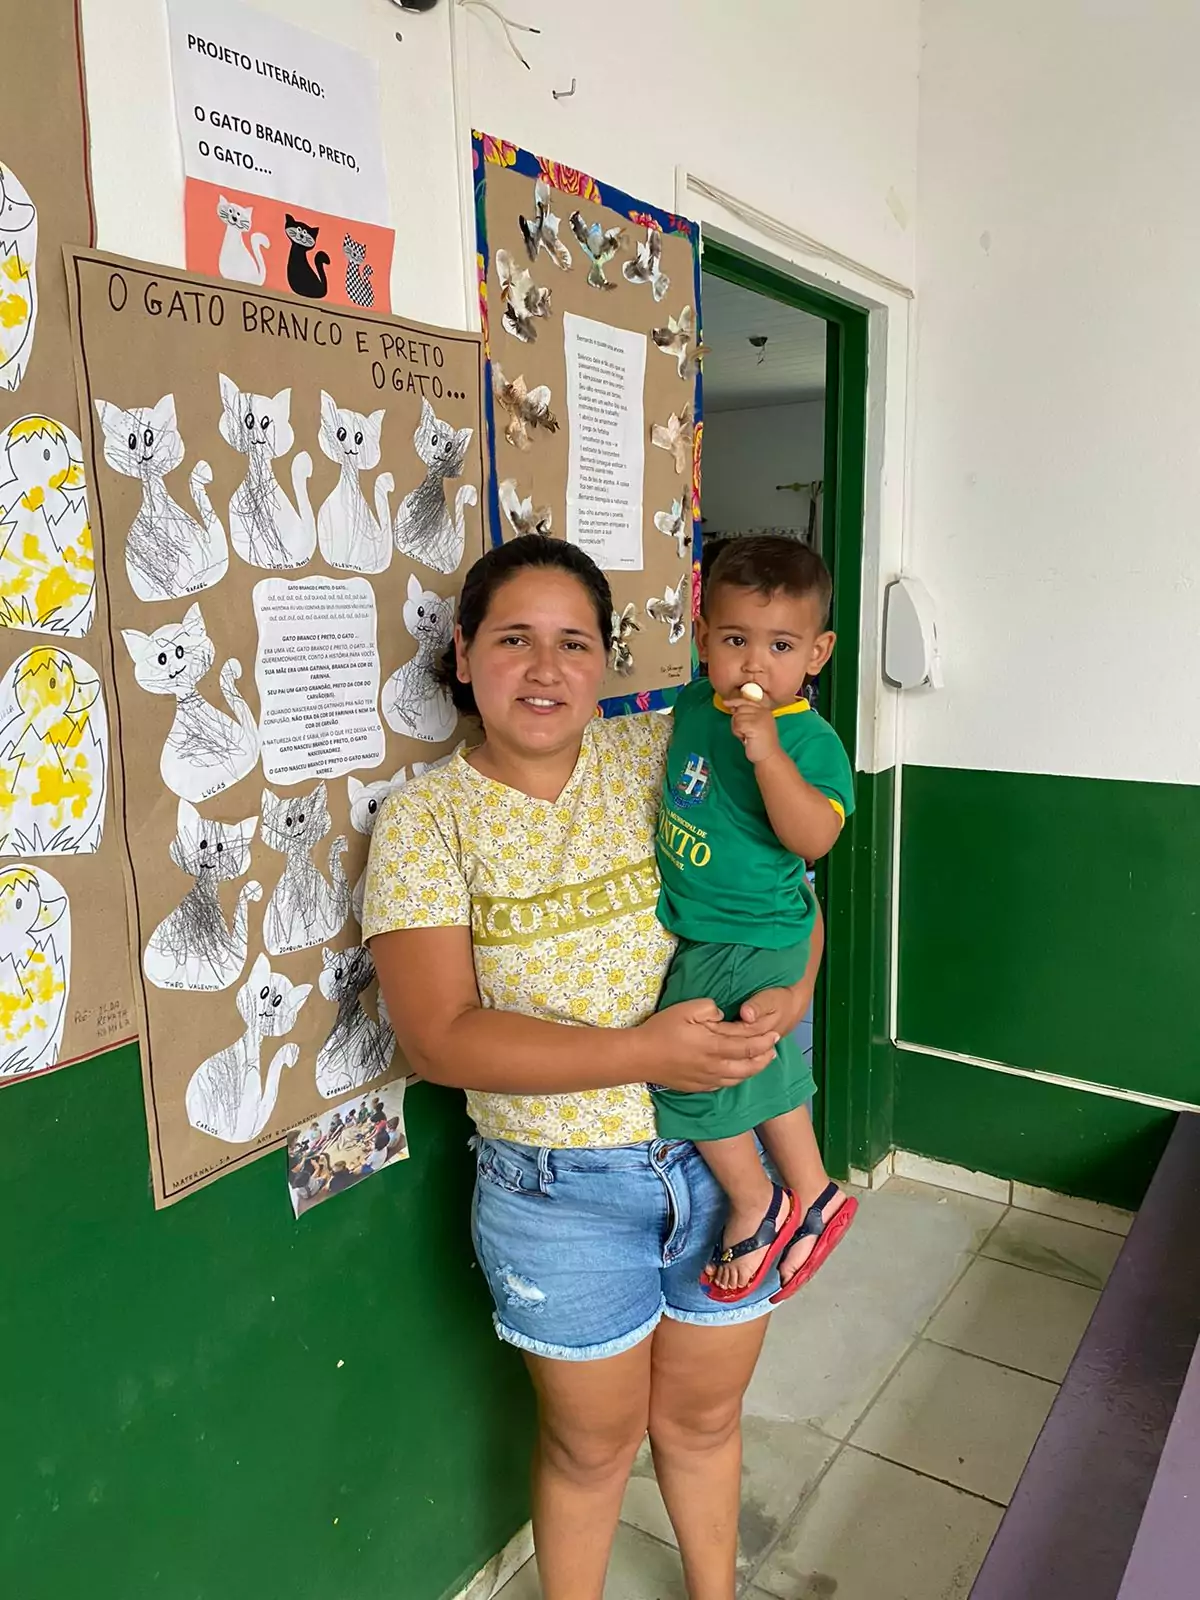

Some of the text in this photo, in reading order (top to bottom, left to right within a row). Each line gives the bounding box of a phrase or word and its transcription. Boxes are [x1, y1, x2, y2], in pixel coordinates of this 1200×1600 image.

[187, 34, 325, 100] PROJETO LITERÁRIO:
[194, 106, 360, 173] O GATO BRANCO, PRETO,
[199, 141, 272, 175] O GATO....
[109, 273, 443, 367] O GATO BRANCO E PRETO
[372, 361, 466, 400] O GATO...
[201, 781, 226, 798] LUCAS
[195, 1120, 219, 1135] CARLOS
[172, 1165, 214, 1189] MATERNAL
